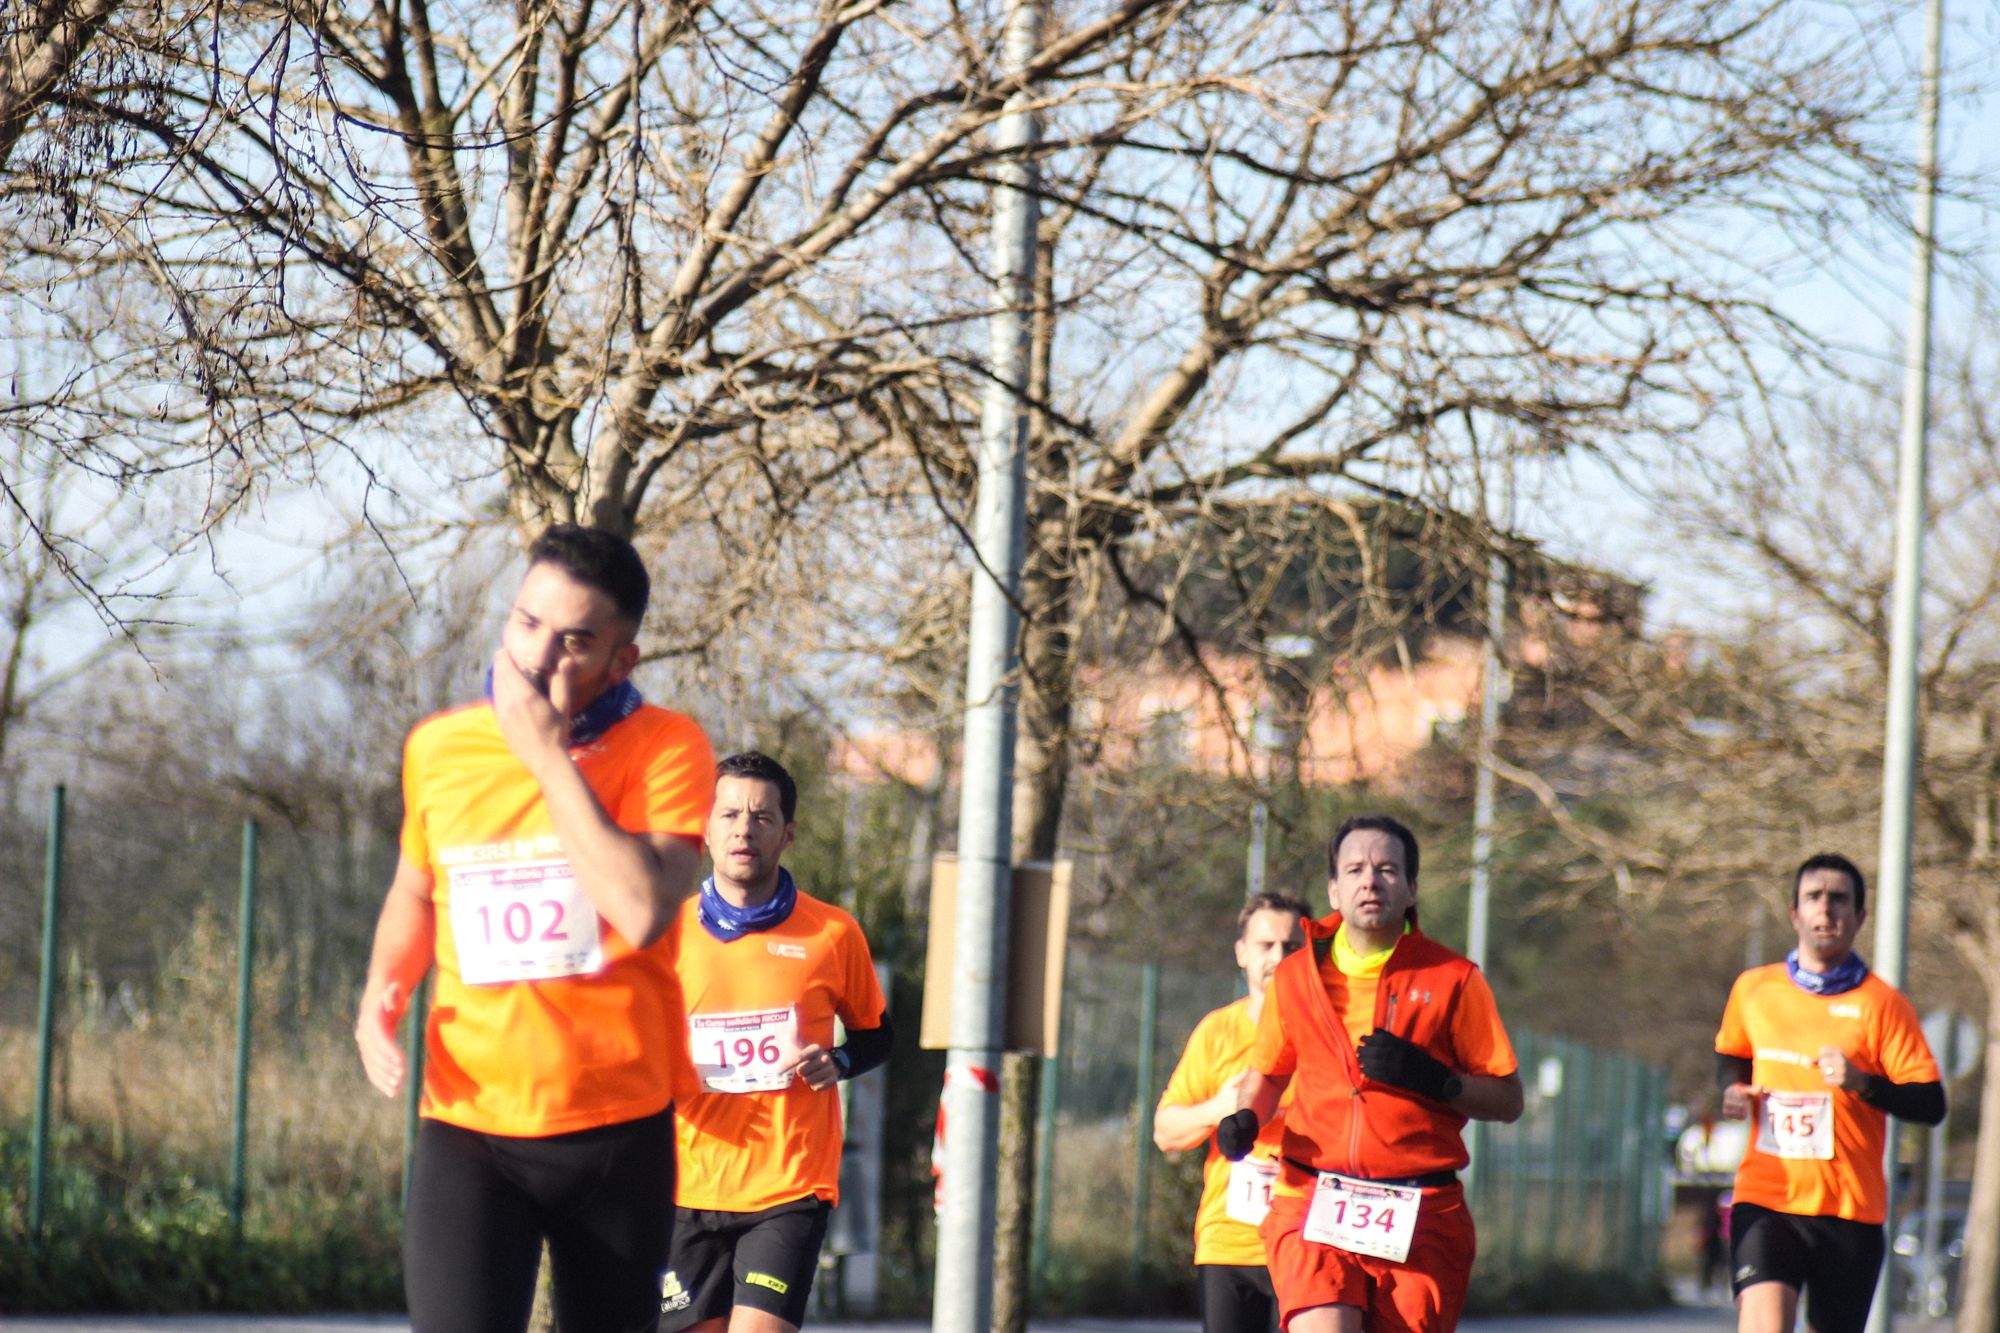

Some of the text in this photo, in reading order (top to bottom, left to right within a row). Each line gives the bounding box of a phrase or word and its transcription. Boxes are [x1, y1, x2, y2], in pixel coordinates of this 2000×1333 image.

[478, 900, 568, 944] 102
[714, 1035, 780, 1068] 196
[1334, 1200, 1395, 1233] 134
